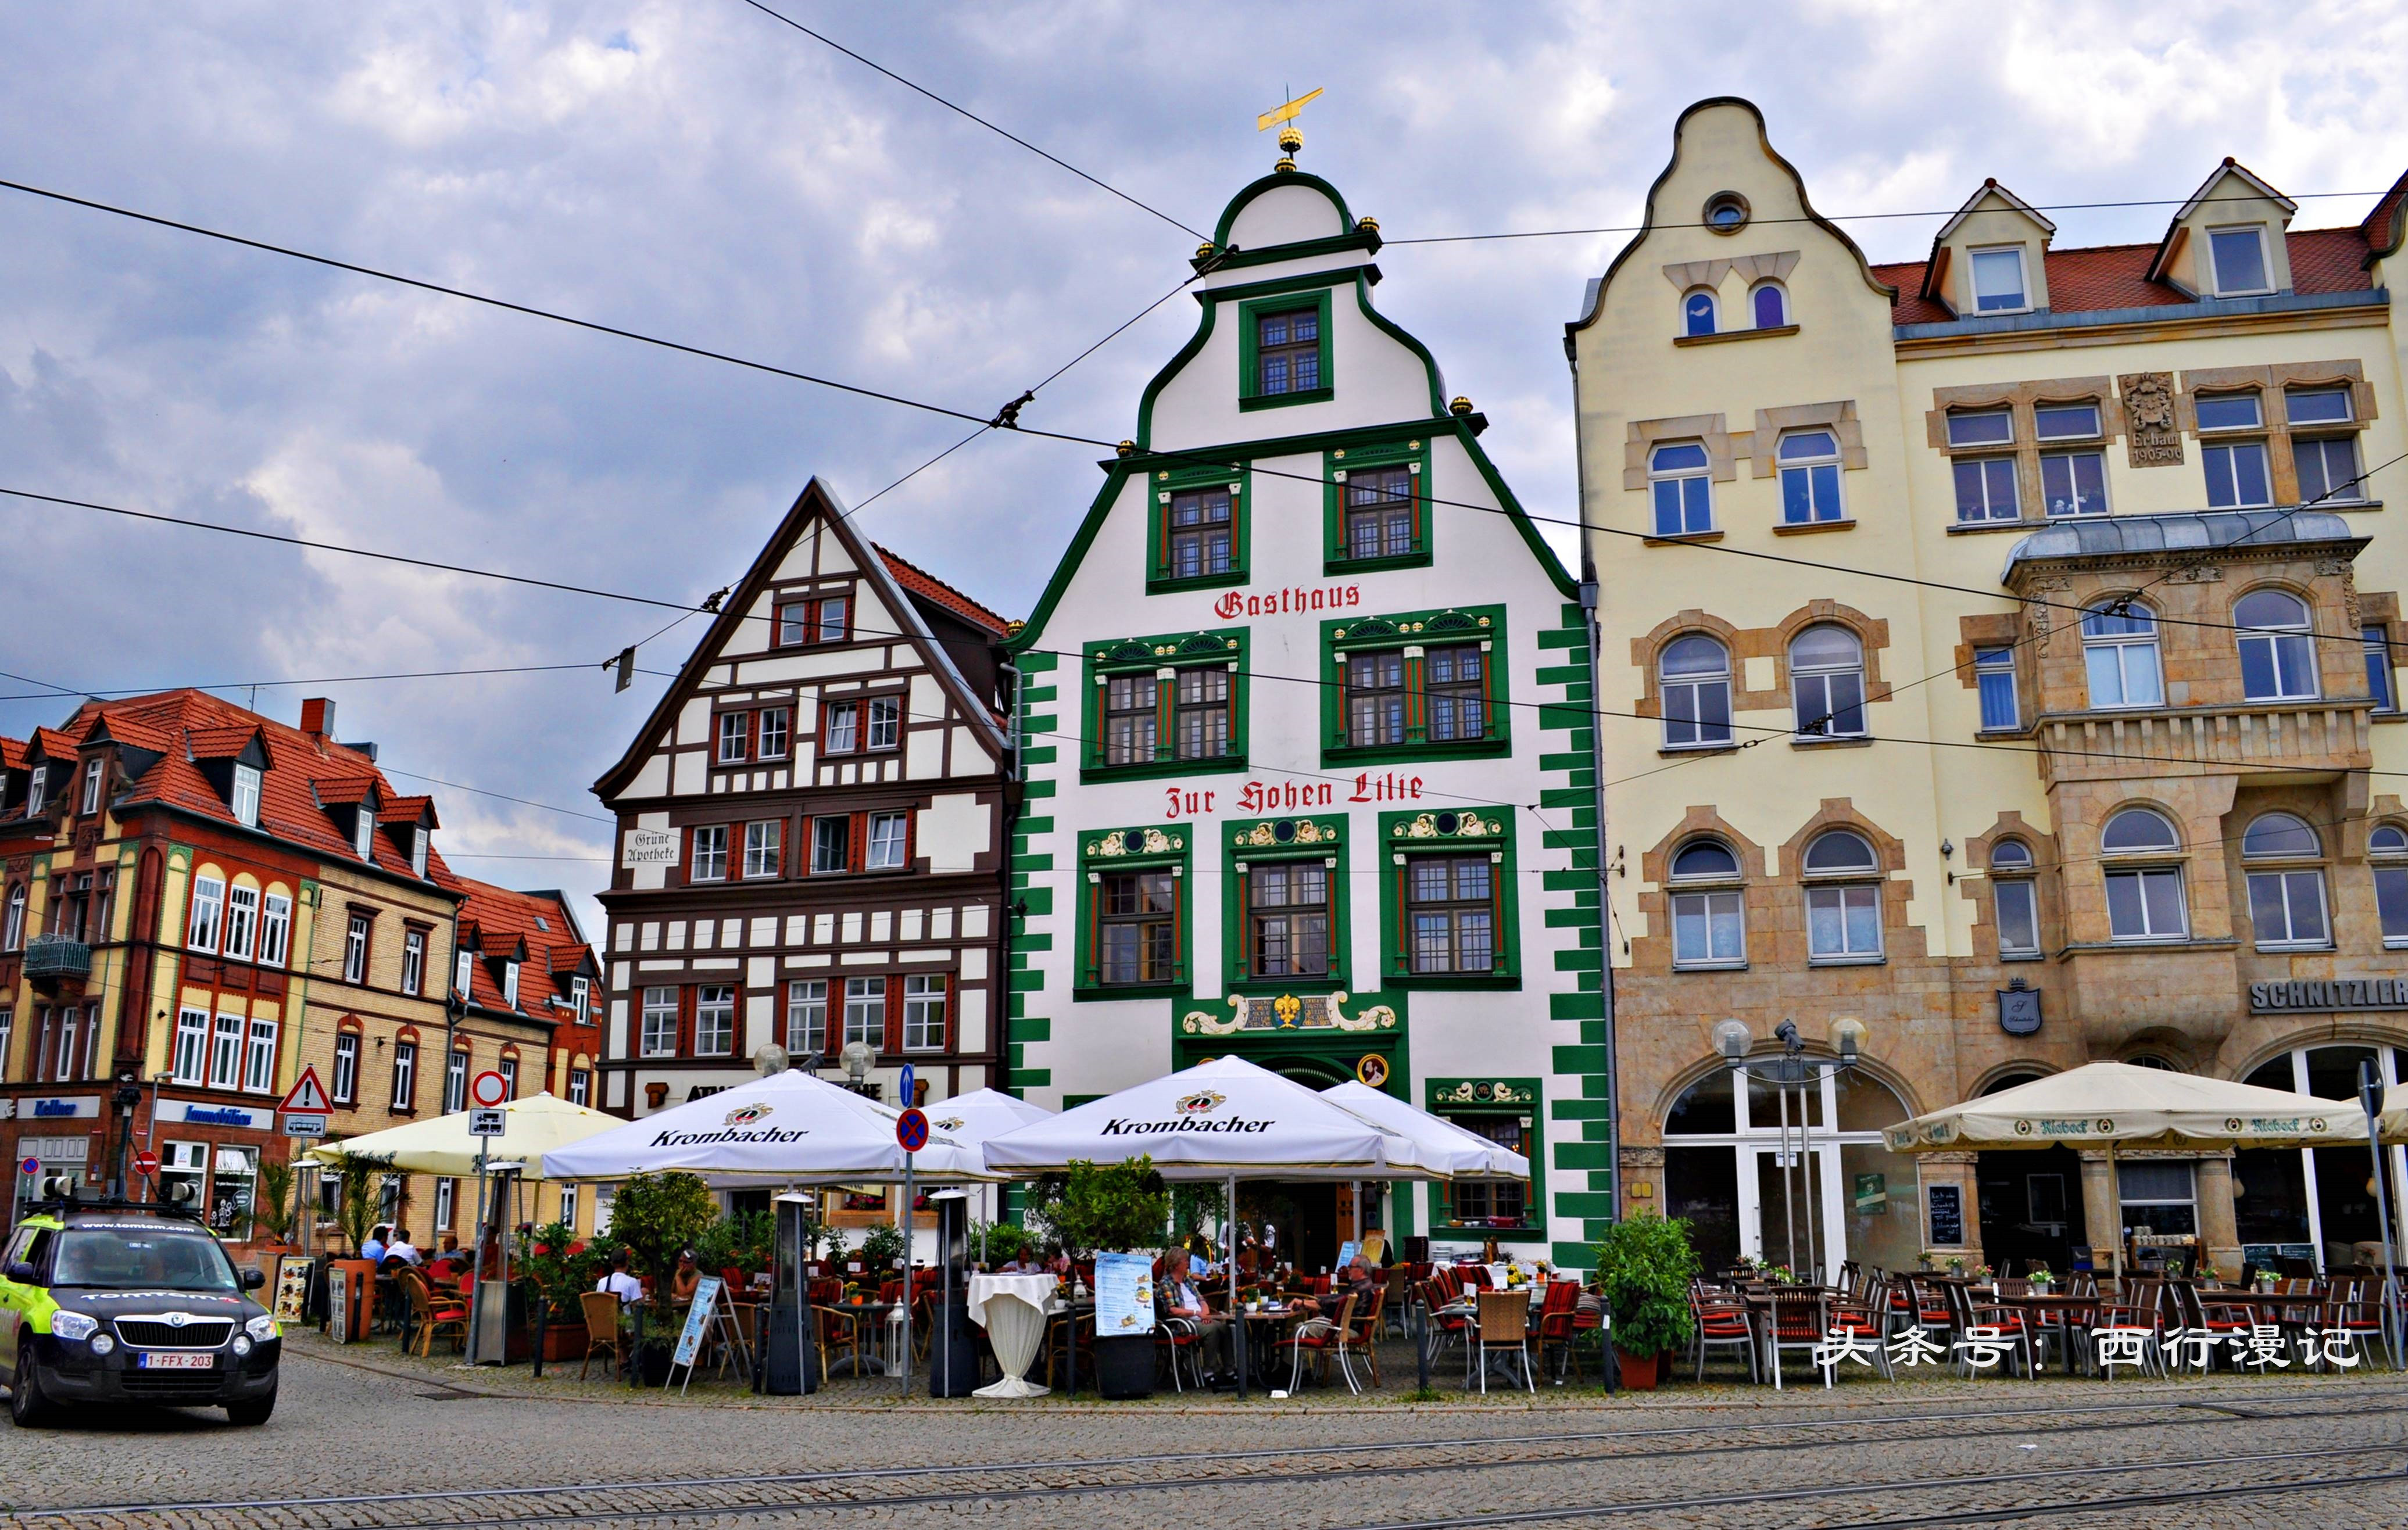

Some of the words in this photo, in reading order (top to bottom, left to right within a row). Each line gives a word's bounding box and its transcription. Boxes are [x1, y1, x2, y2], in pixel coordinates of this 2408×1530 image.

[2134, 447, 2182, 462] 1905-06
[1214, 582, 1360, 621] Gasthaus
[1165, 786, 1216, 819] Zur
[1236, 778, 1333, 815] Hohen
[1347, 770, 1423, 803] Lilie
[635, 831, 670, 847] Grüne
[628, 847, 674, 862] Apotheke
[2250, 977, 2408, 1009] SCHNITZLER
[33, 1099, 77, 1116] Kellner
[184, 1105, 252, 1126] Immobilien
[1100, 1115, 1276, 1135] Krombacher
[649, 1126, 810, 1148] Krombacher
[81, 1223, 195, 1232] www.tomtom.com
[148, 1353, 212, 1367] 1-FFX-203
